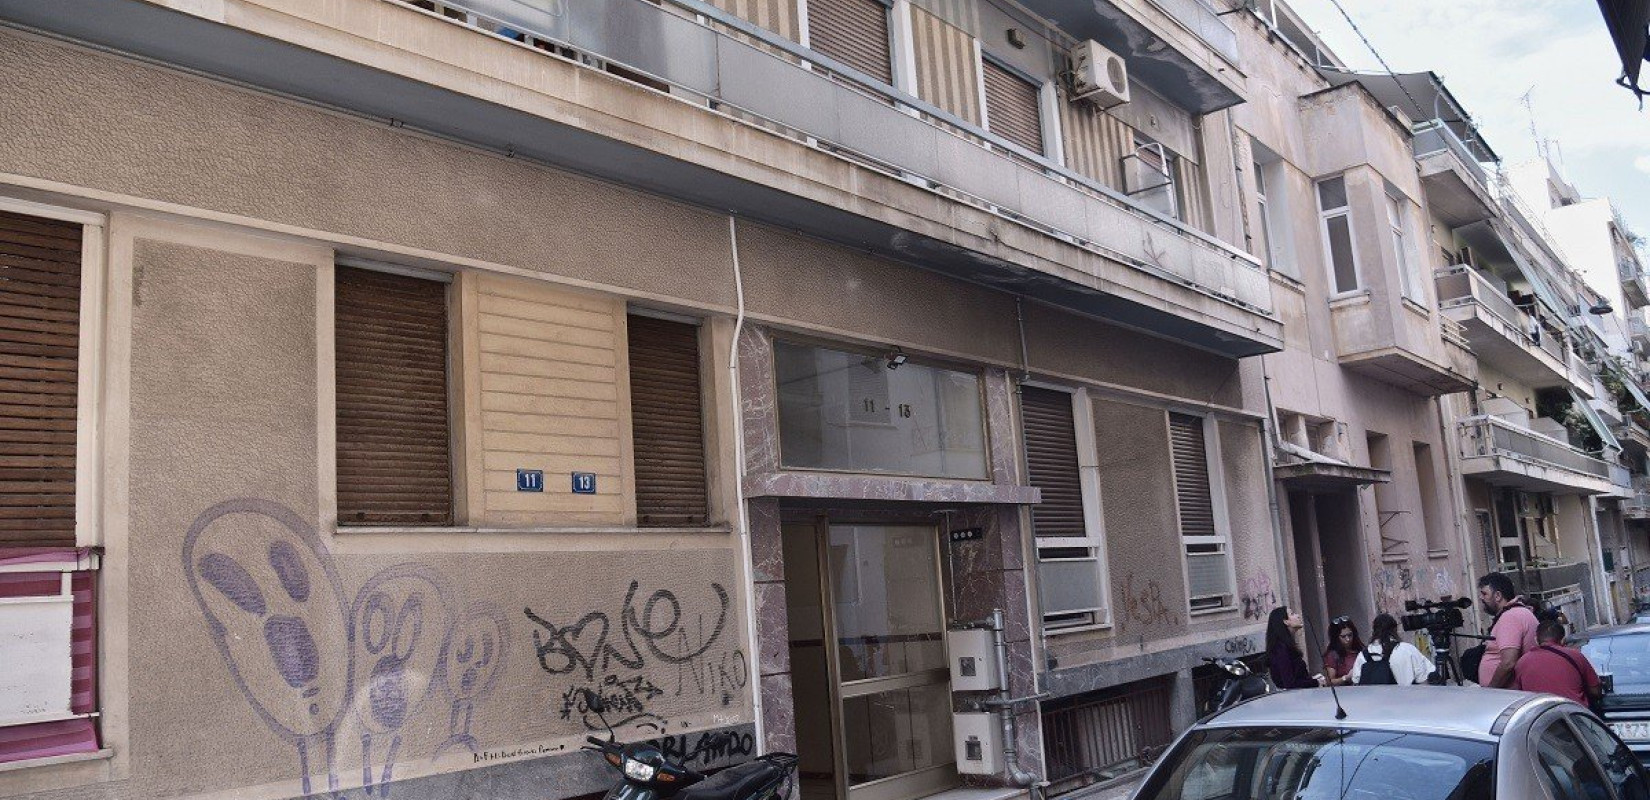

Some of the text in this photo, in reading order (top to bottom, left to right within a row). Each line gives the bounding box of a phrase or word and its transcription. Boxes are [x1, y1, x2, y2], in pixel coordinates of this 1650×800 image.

[863, 398, 875, 412] 11
[898, 403, 911, 419] 13
[525, 473, 536, 488] 11
[578, 476, 591, 490] 13
